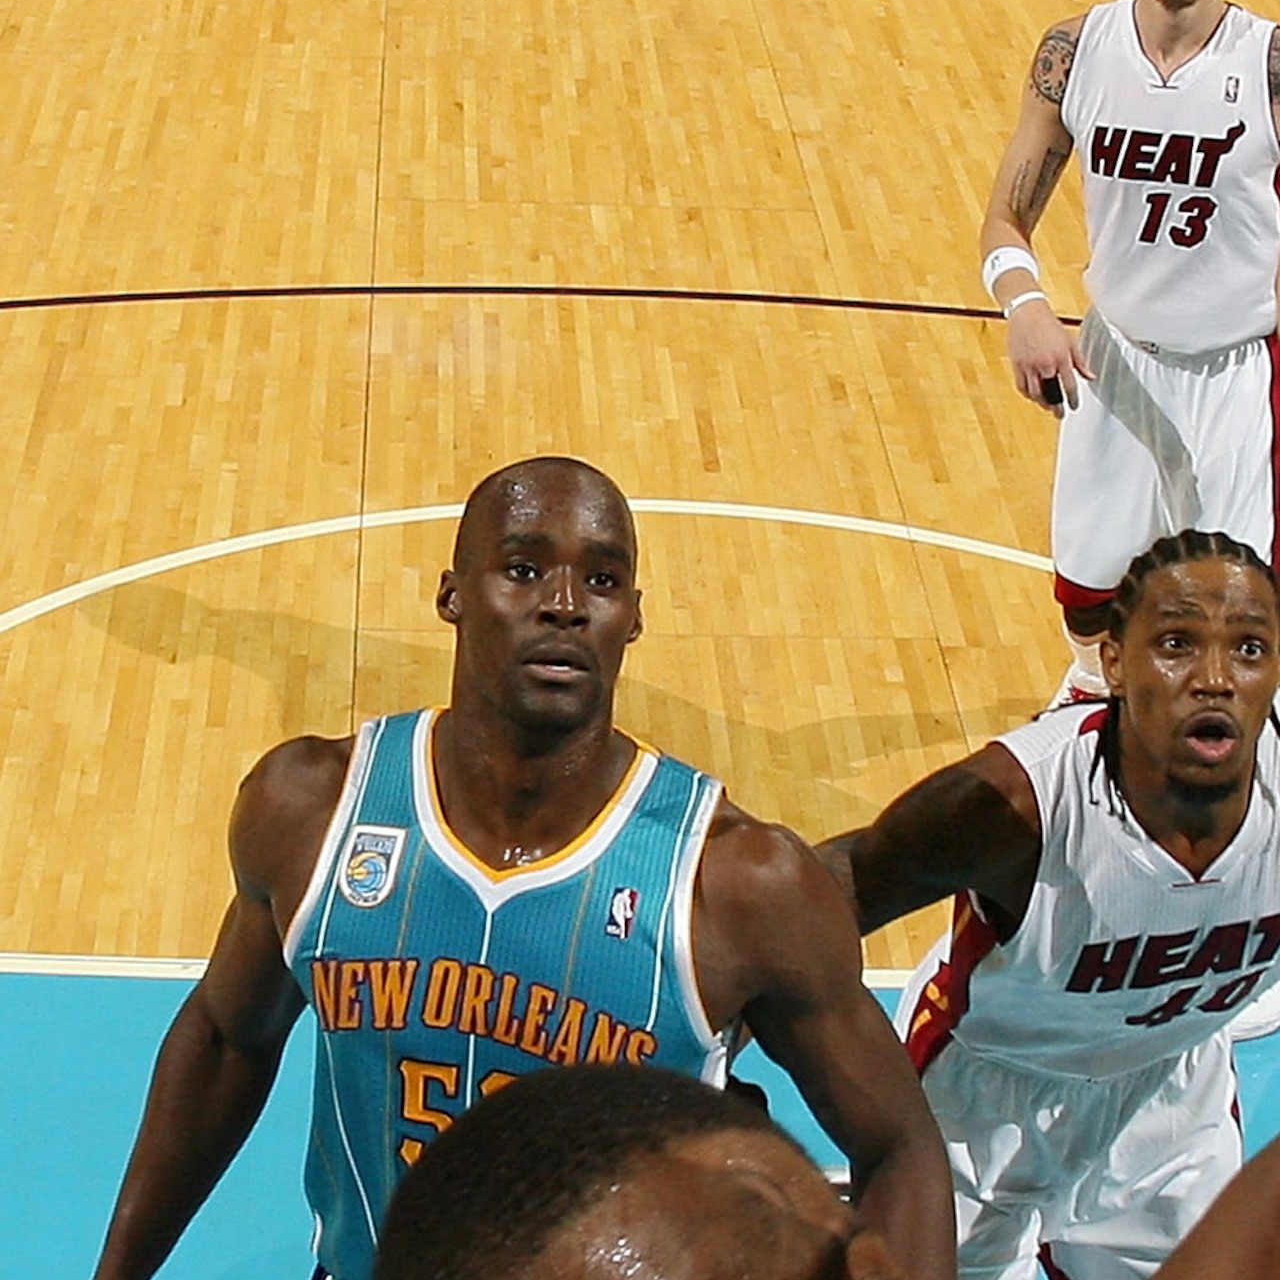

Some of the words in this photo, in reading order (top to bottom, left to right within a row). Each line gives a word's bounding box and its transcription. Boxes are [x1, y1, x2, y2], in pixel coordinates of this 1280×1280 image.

[1090, 119, 1247, 189] HEAT
[1138, 192, 1218, 249] 13
[310, 957, 419, 1034] NEW
[421, 957, 659, 1067] ORLEANS
[1124, 967, 1266, 1028] 40
[398, 1057, 518, 1168] 5
